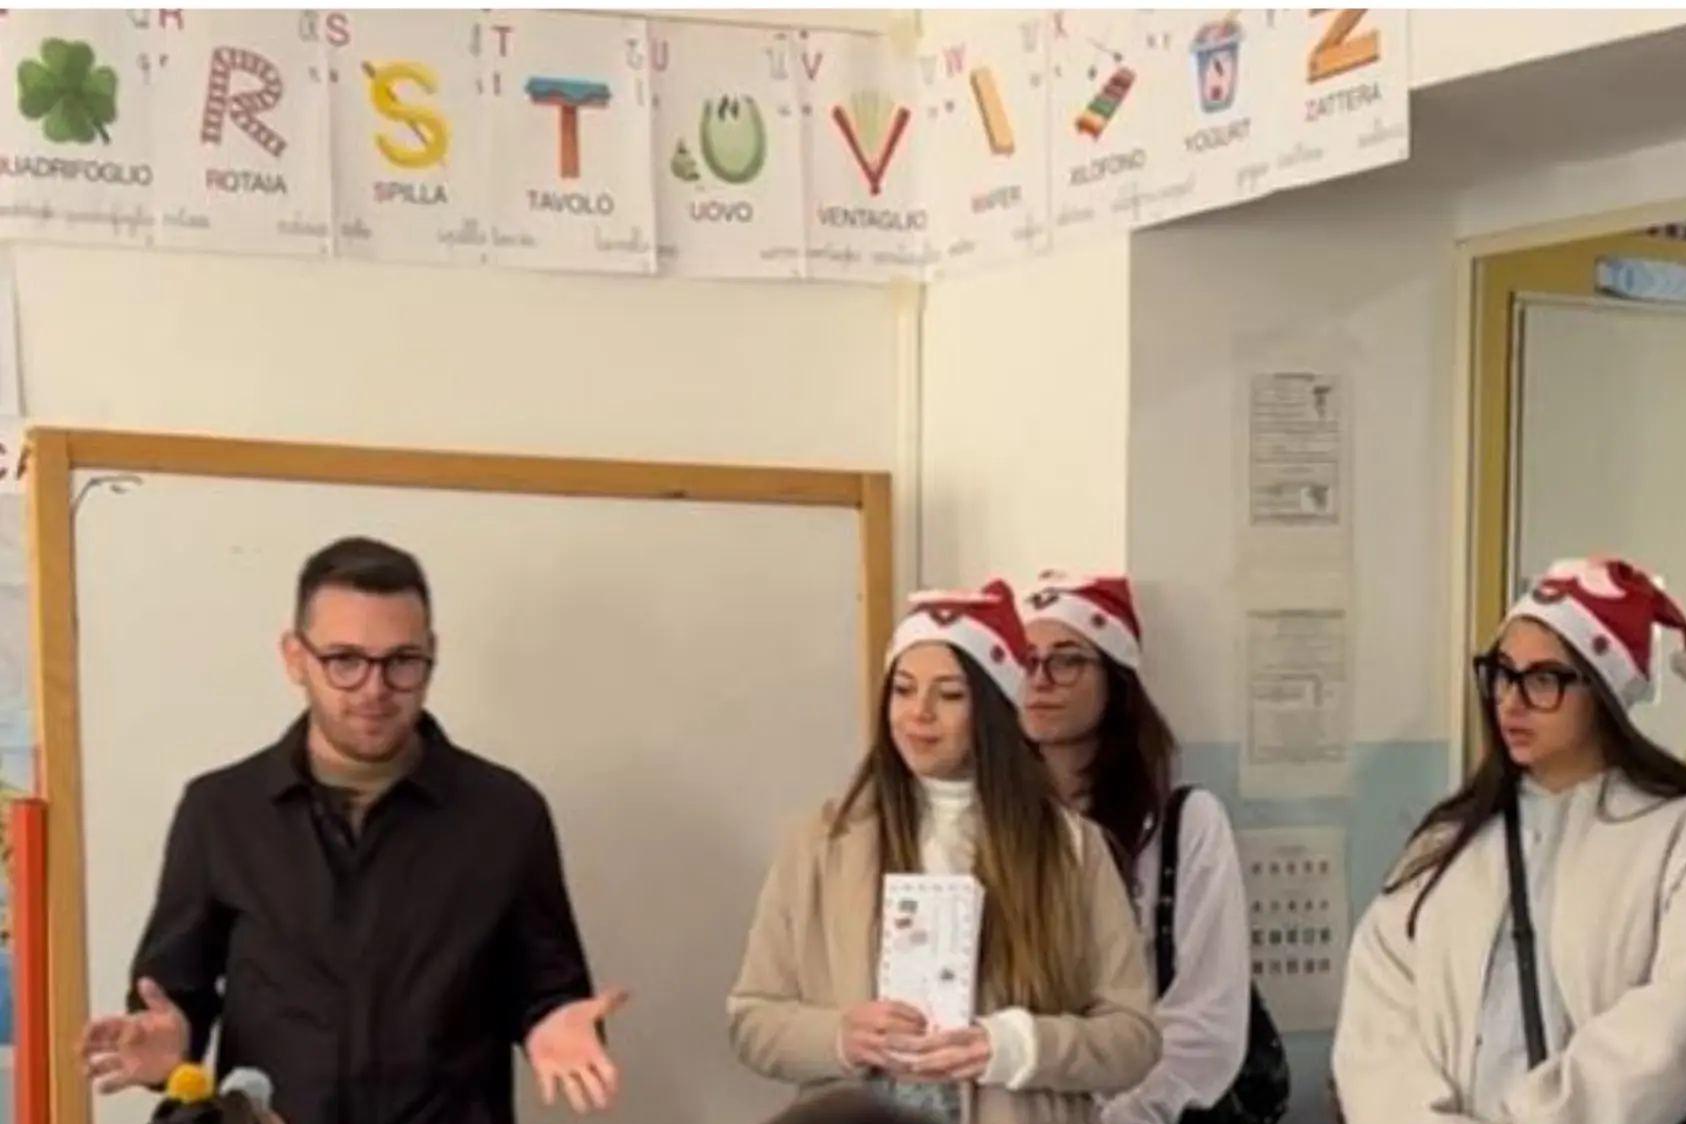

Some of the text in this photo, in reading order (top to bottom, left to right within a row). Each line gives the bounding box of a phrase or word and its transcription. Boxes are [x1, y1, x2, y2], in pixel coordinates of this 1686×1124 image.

[1305, 82, 1382, 122] ZATTERA
[1185, 117, 1252, 153] YOGURT
[1070, 148, 1147, 186] XILOFONO
[205, 168, 287, 195] ROTAIA
[373, 180, 447, 205] SPILLA
[527, 189, 614, 215] TAVOLO
[691, 200, 753, 222] UOVO
[818, 205, 928, 231] VENTAGLIO
